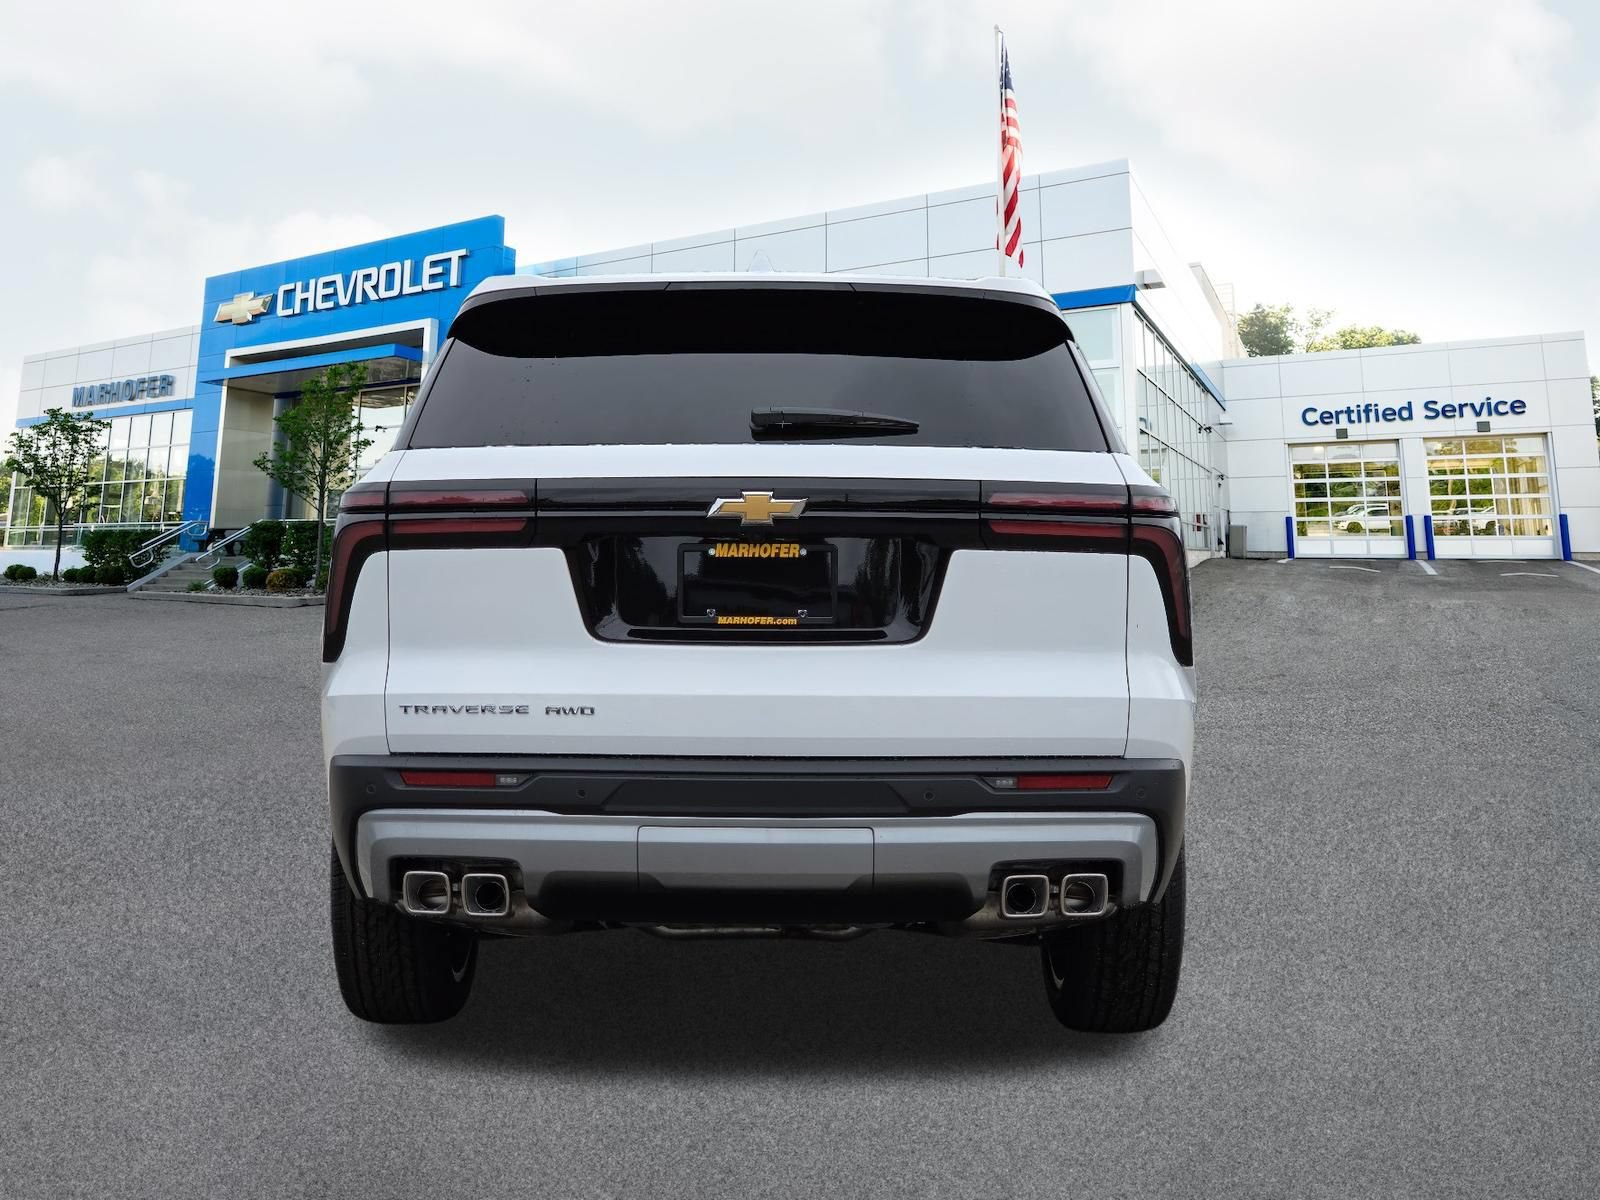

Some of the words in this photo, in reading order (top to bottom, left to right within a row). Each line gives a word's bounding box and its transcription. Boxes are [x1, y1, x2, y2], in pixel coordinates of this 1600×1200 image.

[276, 248, 469, 318] CHEVROLET
[72, 374, 175, 408] MARHOFER
[1301, 401, 1414, 426] Certified
[1424, 396, 1527, 420] Service
[715, 543, 800, 559] MARHOFER
[717, 615, 798, 626] MARHOFER.com
[399, 704, 530, 715] TRAVERSE
[545, 706, 596, 717] AWD
